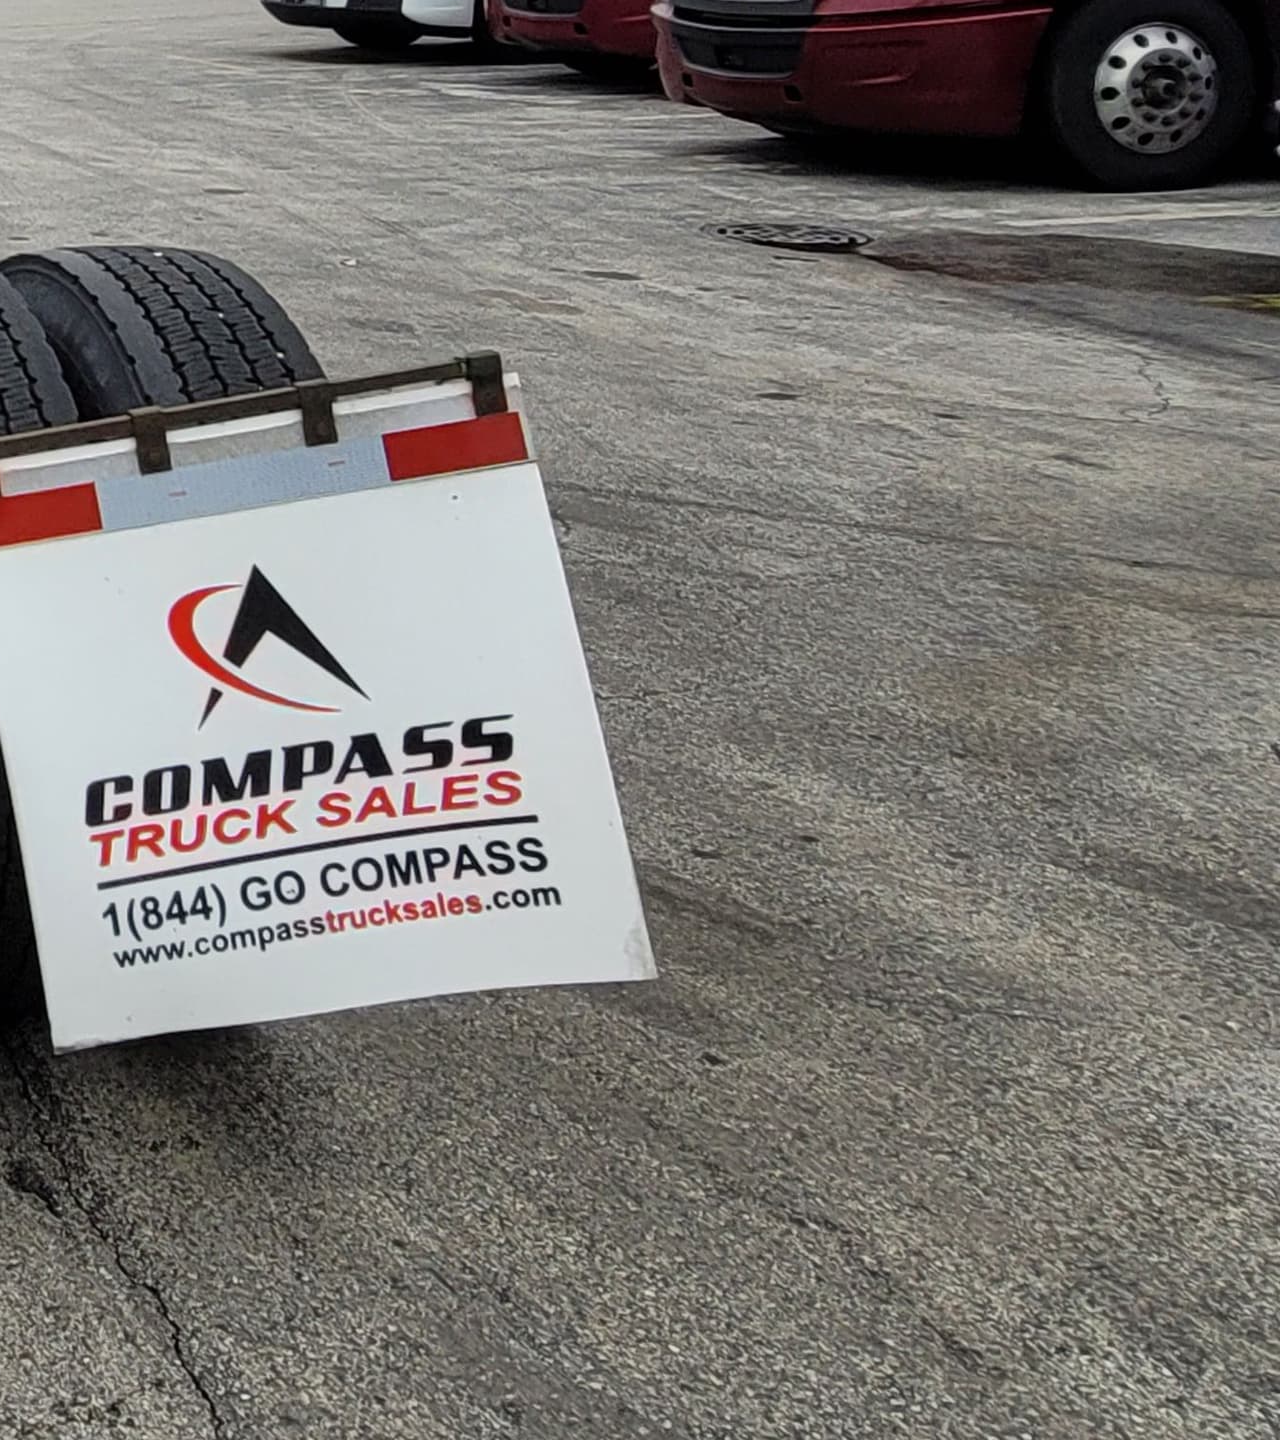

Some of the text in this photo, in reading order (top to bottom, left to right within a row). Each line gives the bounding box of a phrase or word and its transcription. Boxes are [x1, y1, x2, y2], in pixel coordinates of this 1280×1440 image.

[85, 714, 515, 829] COMPASS
[90, 770, 523, 867] TRUCK SALES
[102, 837, 549, 943] 1(844) GO COMPASS
[113, 885, 563, 969] www.compasstrucksales.com
